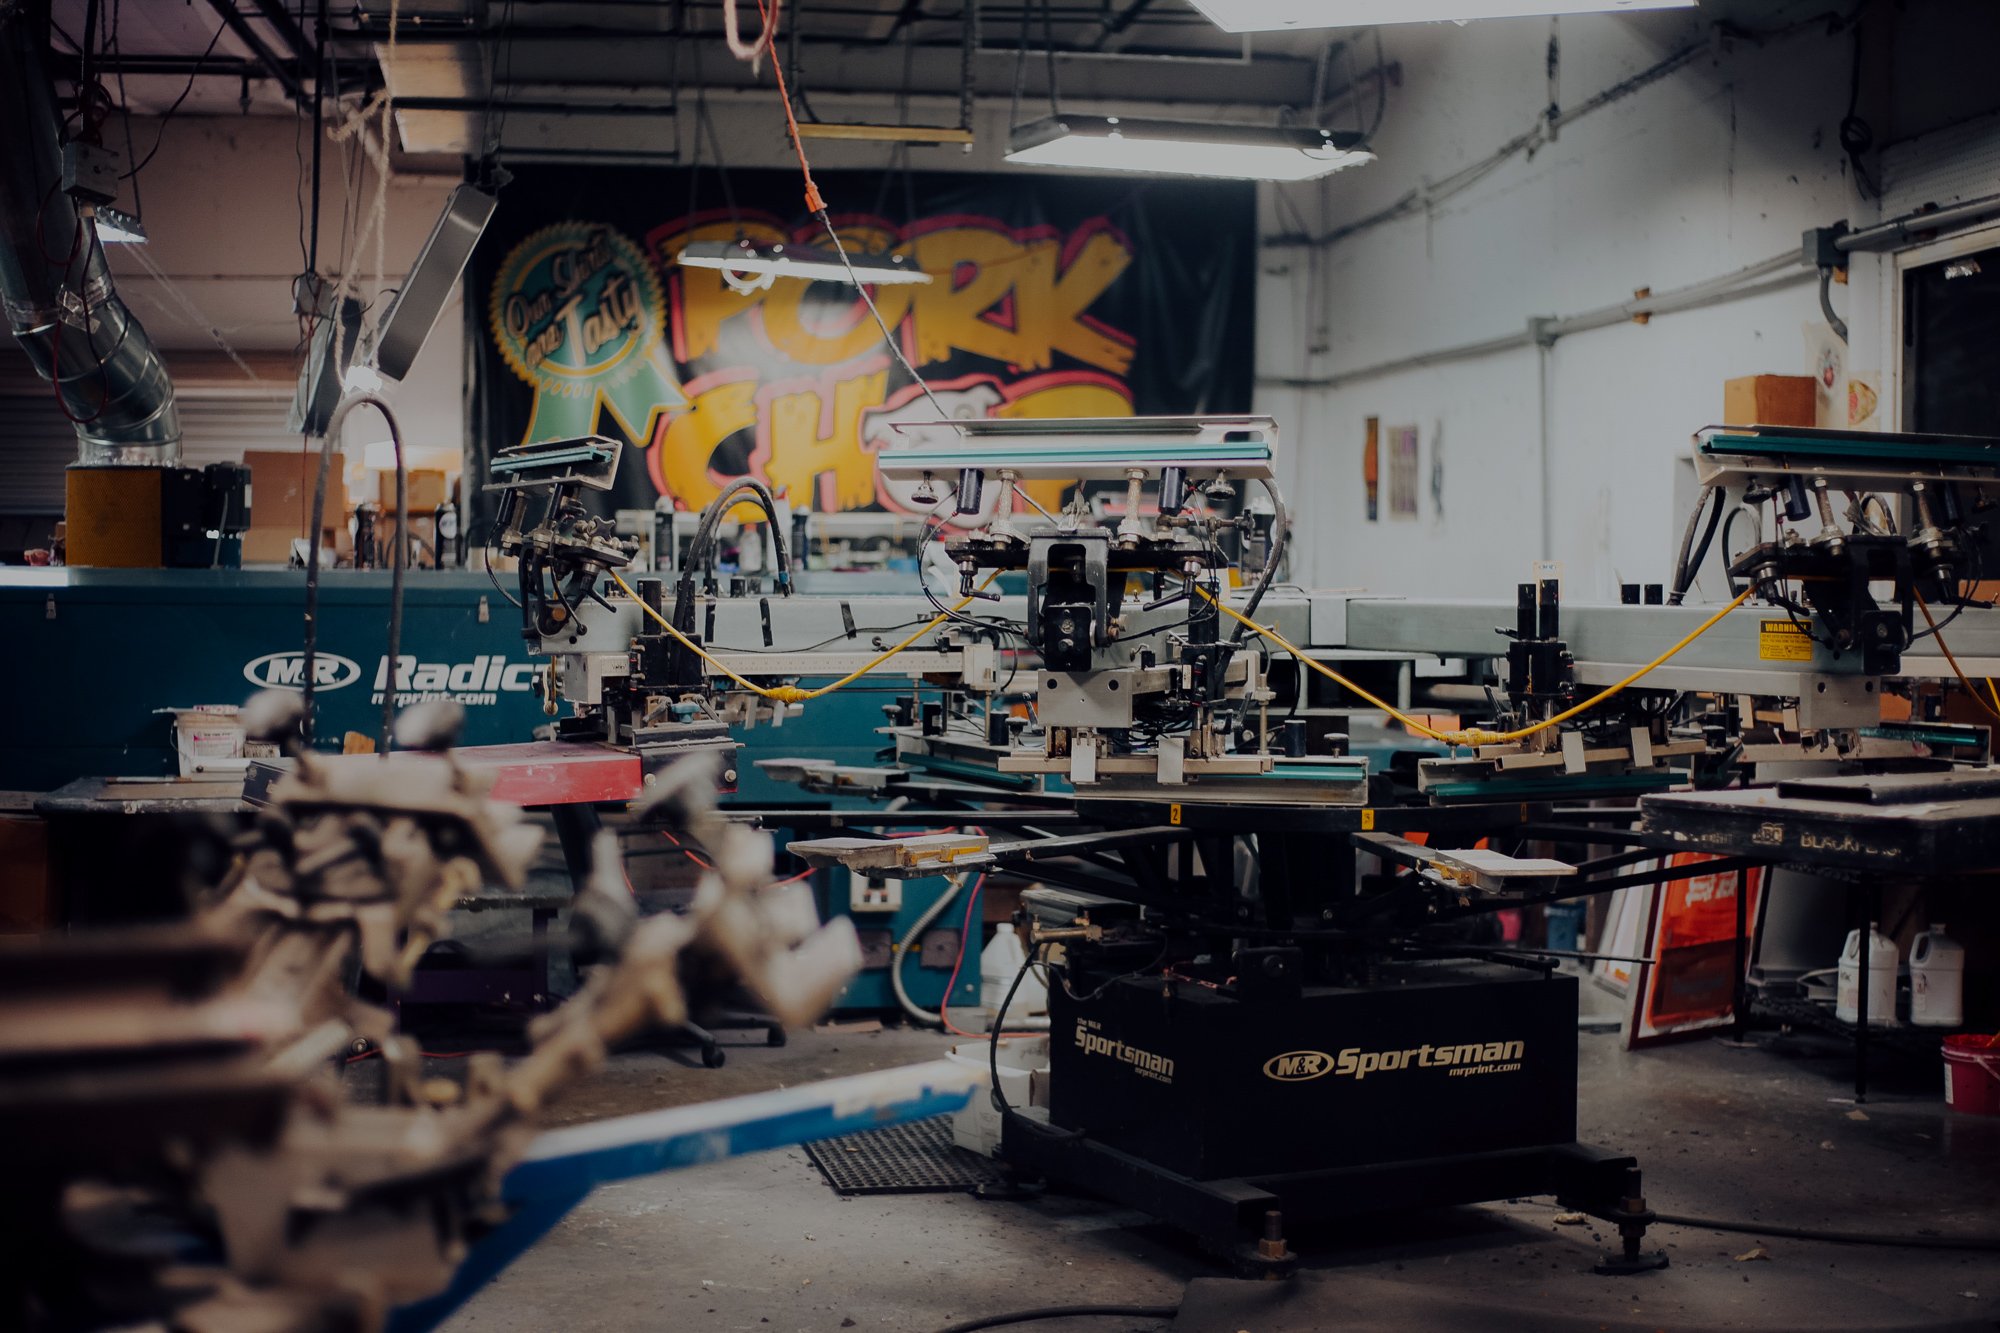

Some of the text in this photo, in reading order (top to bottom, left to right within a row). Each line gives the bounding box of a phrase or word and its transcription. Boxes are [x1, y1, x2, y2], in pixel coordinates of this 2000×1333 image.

[554, 274, 646, 367] Tasty
[648, 212, 1138, 378] PORK
[1074, 1025, 1175, 1077] Sportsman
[1277, 1040, 1525, 1080] M&R Sportsman
[1449, 1062, 1521, 1078] mrprint.com
